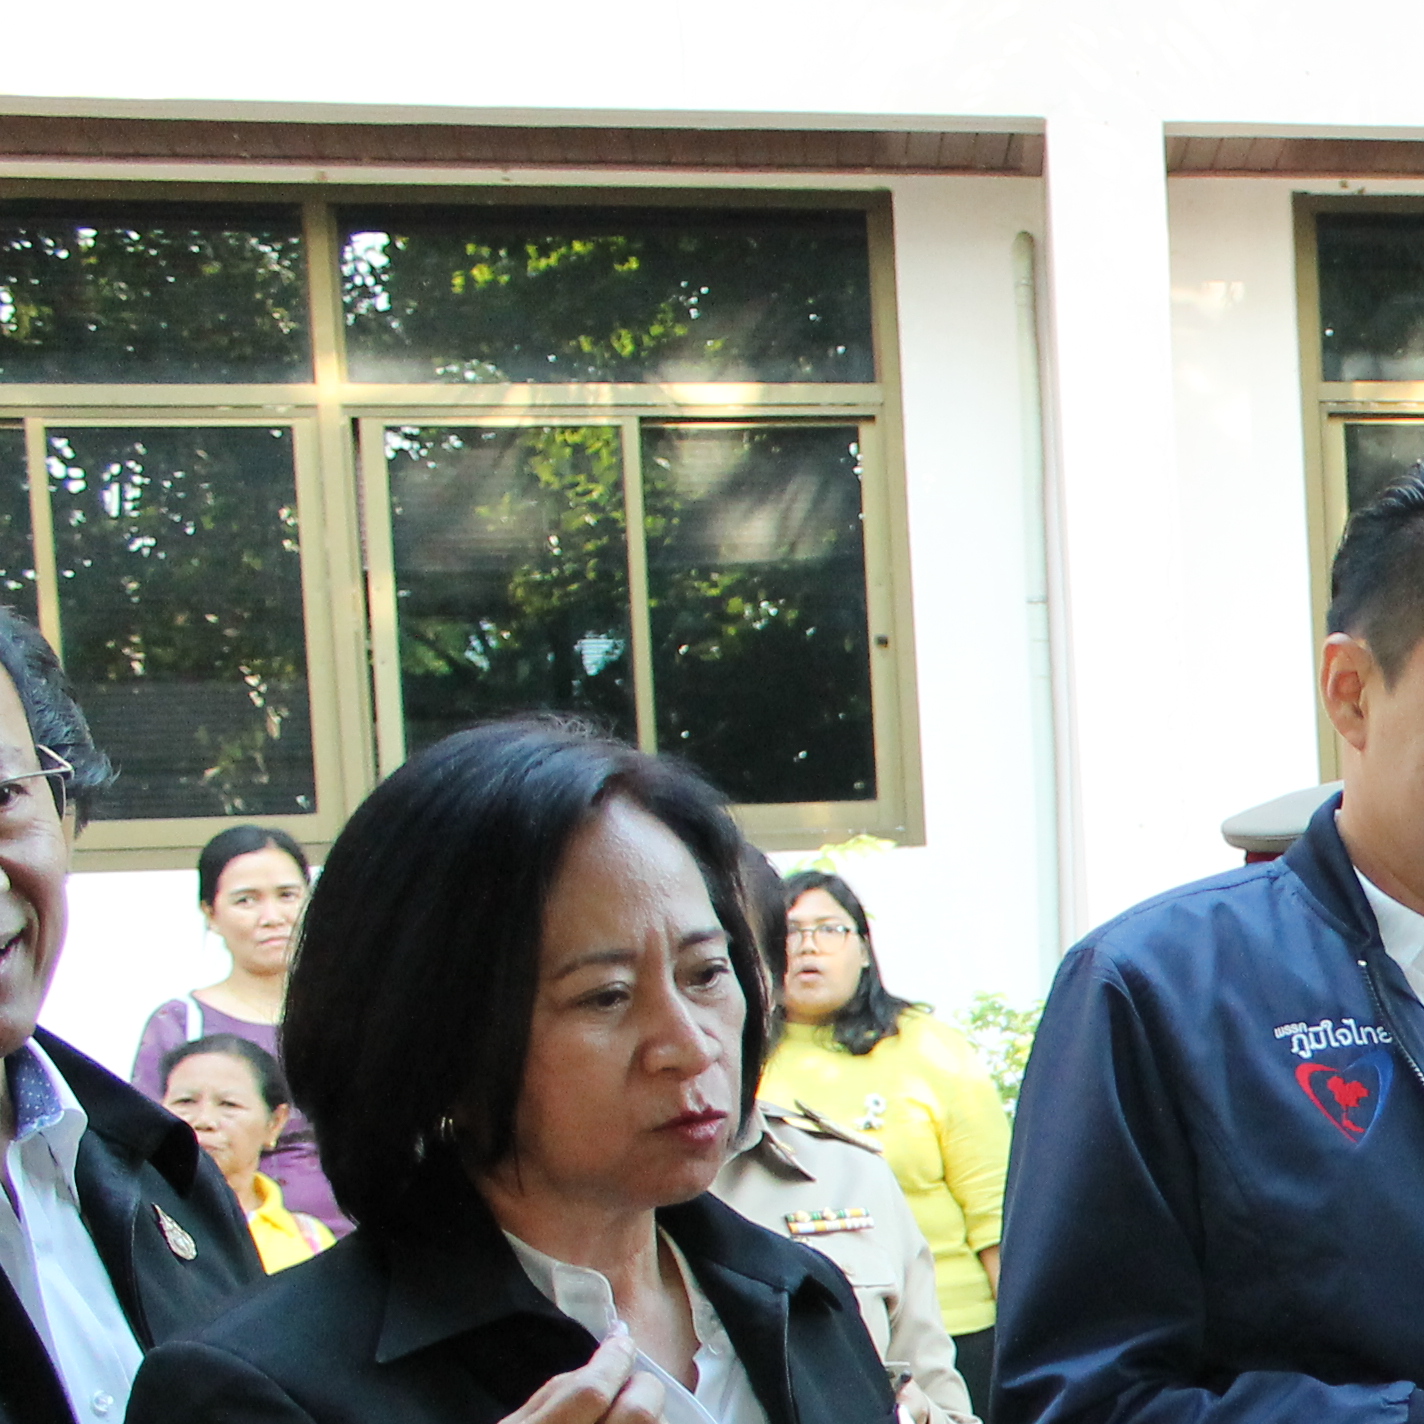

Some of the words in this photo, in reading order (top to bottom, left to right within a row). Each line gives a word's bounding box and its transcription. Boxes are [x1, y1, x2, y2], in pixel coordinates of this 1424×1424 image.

[1274, 1022, 1308, 1039] พรรค
[1290, 1018, 1394, 1059] ภูมิใจไทย
